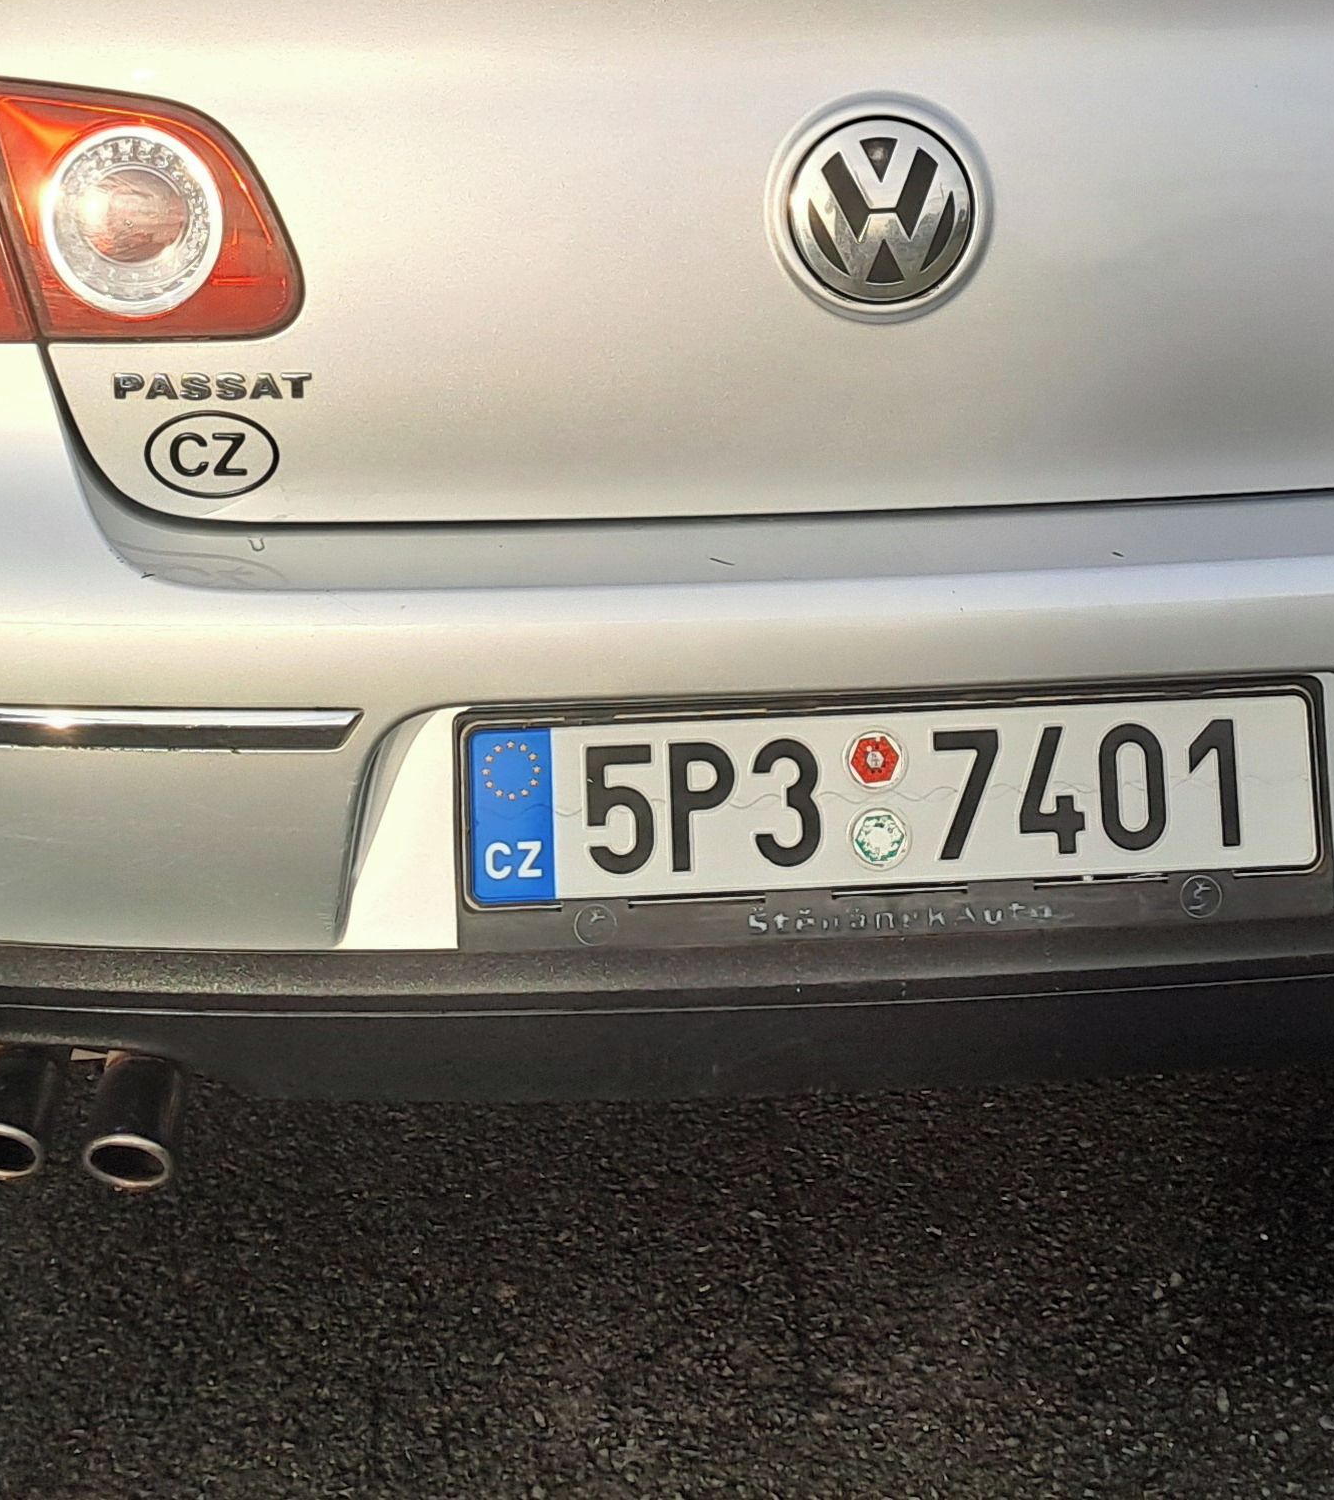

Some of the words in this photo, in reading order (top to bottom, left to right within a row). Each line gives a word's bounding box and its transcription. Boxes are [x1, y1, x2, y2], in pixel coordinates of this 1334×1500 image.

[112, 371, 313, 401] PASSAT
[169, 431, 248, 477] CZ
[584, 737, 822, 875] 5P3
[931, 718, 1242, 862] 7401
[484, 840, 544, 881] CZ
